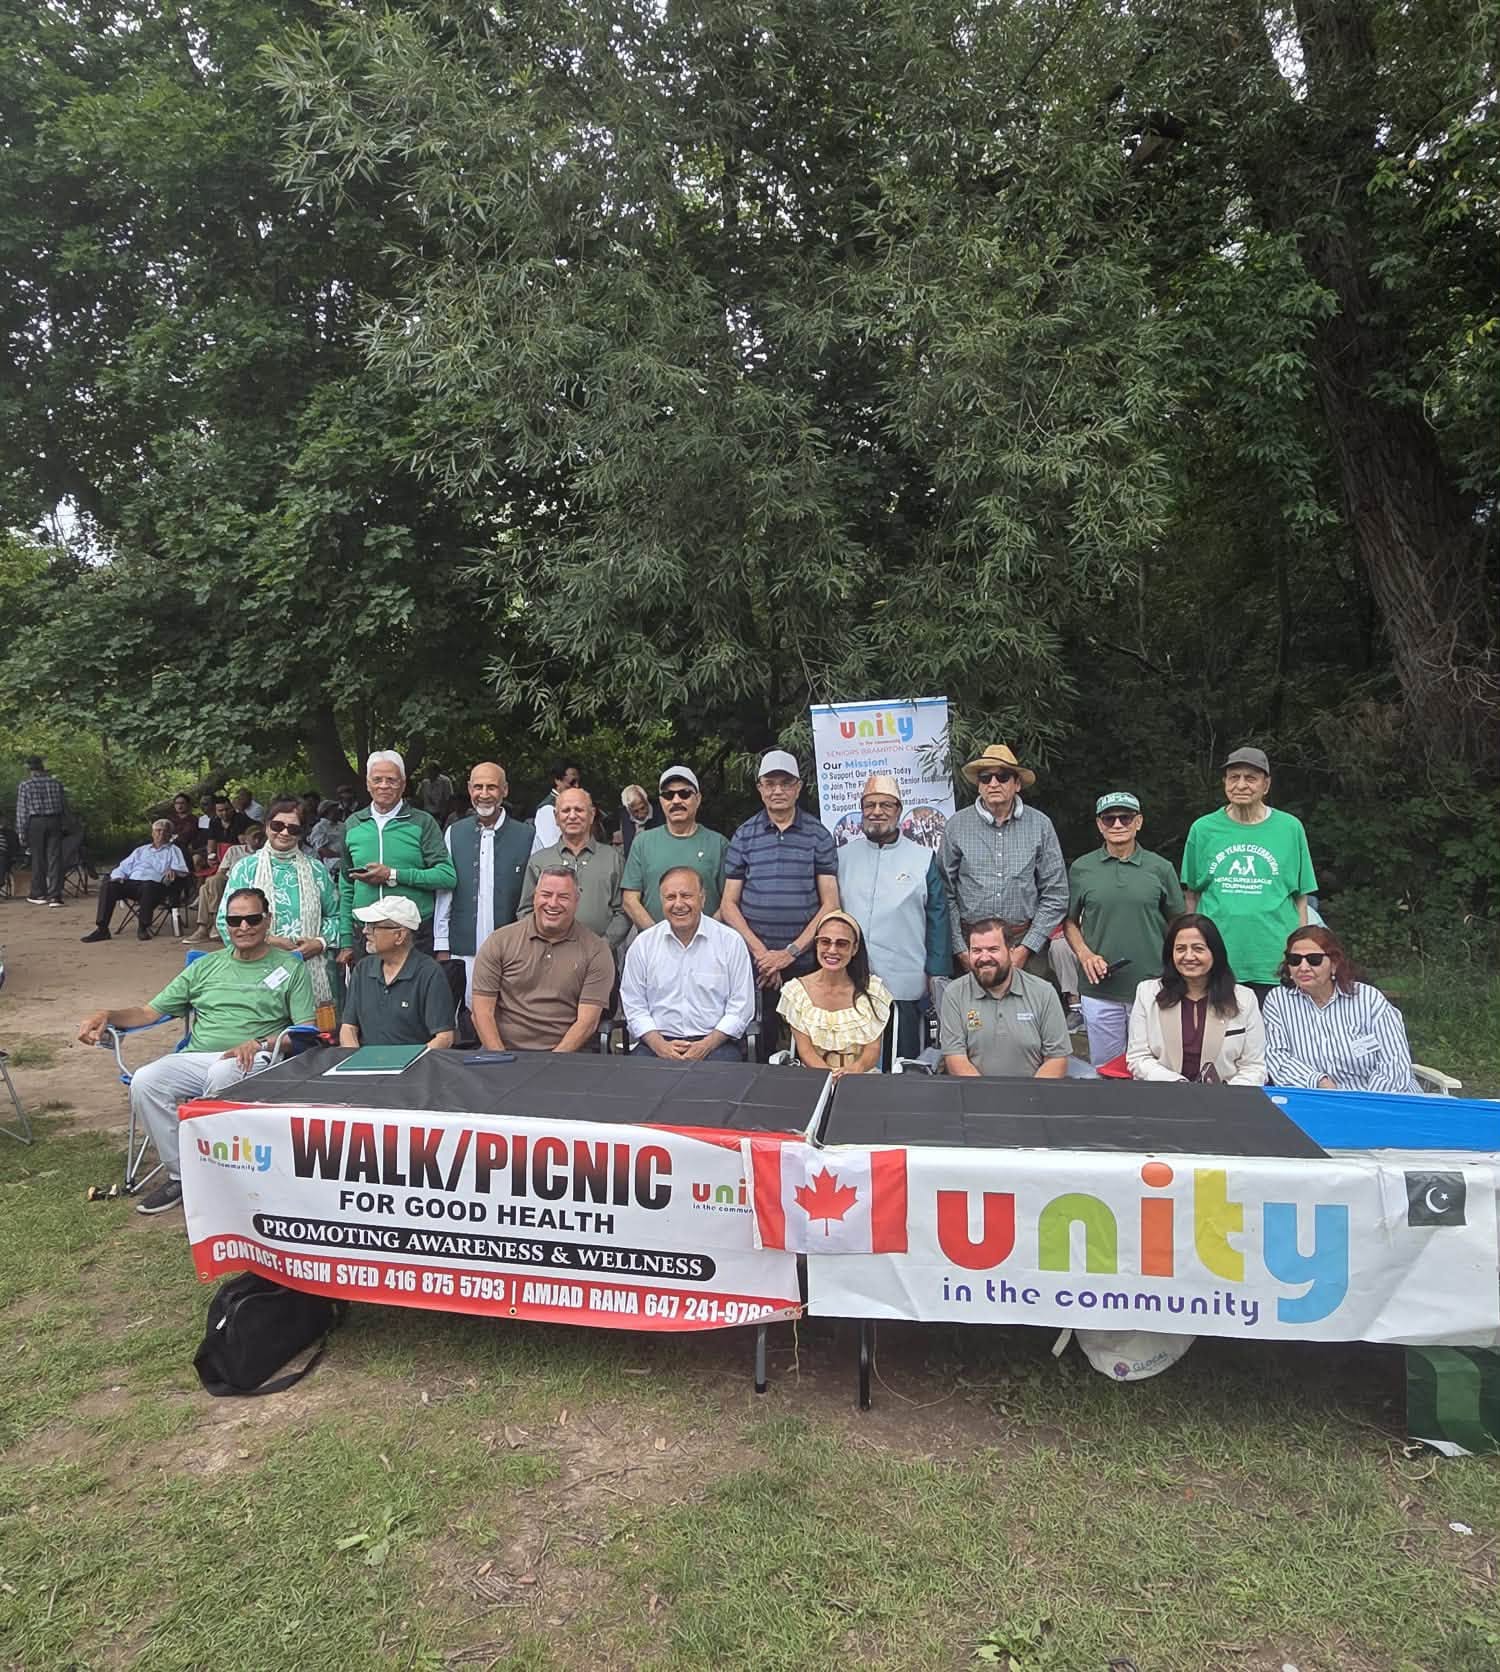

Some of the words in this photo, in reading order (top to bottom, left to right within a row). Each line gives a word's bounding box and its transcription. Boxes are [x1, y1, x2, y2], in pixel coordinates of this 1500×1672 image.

[840, 712, 913, 742] unity
[823, 762, 843, 771] Our
[845, 758, 888, 769] Mission!
[829, 770, 854, 780] Support
[855, 769, 867, 778] Our
[868, 768, 892, 777] Seniors
[894, 767, 911, 776] Today
[830, 783, 844, 791] Join
[844, 781, 857, 789] The
[900, 776, 920, 785] Senior
[831, 793, 846, 801] Help
[832, 803, 857, 813] Support
[1221, 882, 1263, 890] TOURNAMENT
[197, 1135, 272, 1172] unity
[290, 1116, 672, 1210] WALK/PICNIC
[692, 1177, 747, 1205] uni
[339, 1190, 395, 1215] FOR
[404, 1195, 487, 1223] GOOD
[497, 1203, 614, 1234] HEALTH
[718, 1206, 754, 1215] commun
[261, 1216, 401, 1249] PROMOTING
[406, 1236, 544, 1263] AWARENESS
[550, 1246, 572, 1266] &
[577, 1248, 702, 1277] WELLNESS
[937, 1162, 1349, 1324] unity
[212, 1240, 283, 1273] CONTACT:
[284, 1258, 331, 1284] FASIH
[336, 1265, 379, 1289] SYED
[384, 1268, 416, 1292] 416
[421, 1272, 454, 1296] 875
[459, 1276, 505, 1301] 5793
[522, 1281, 584, 1309] AMJAD
[589, 1287, 638, 1315] RANA
[644, 1293, 679, 1318] 647
[942, 1276, 972, 1303] in
[985, 1278, 1041, 1305] the
[1054, 1287, 1260, 1327] community
